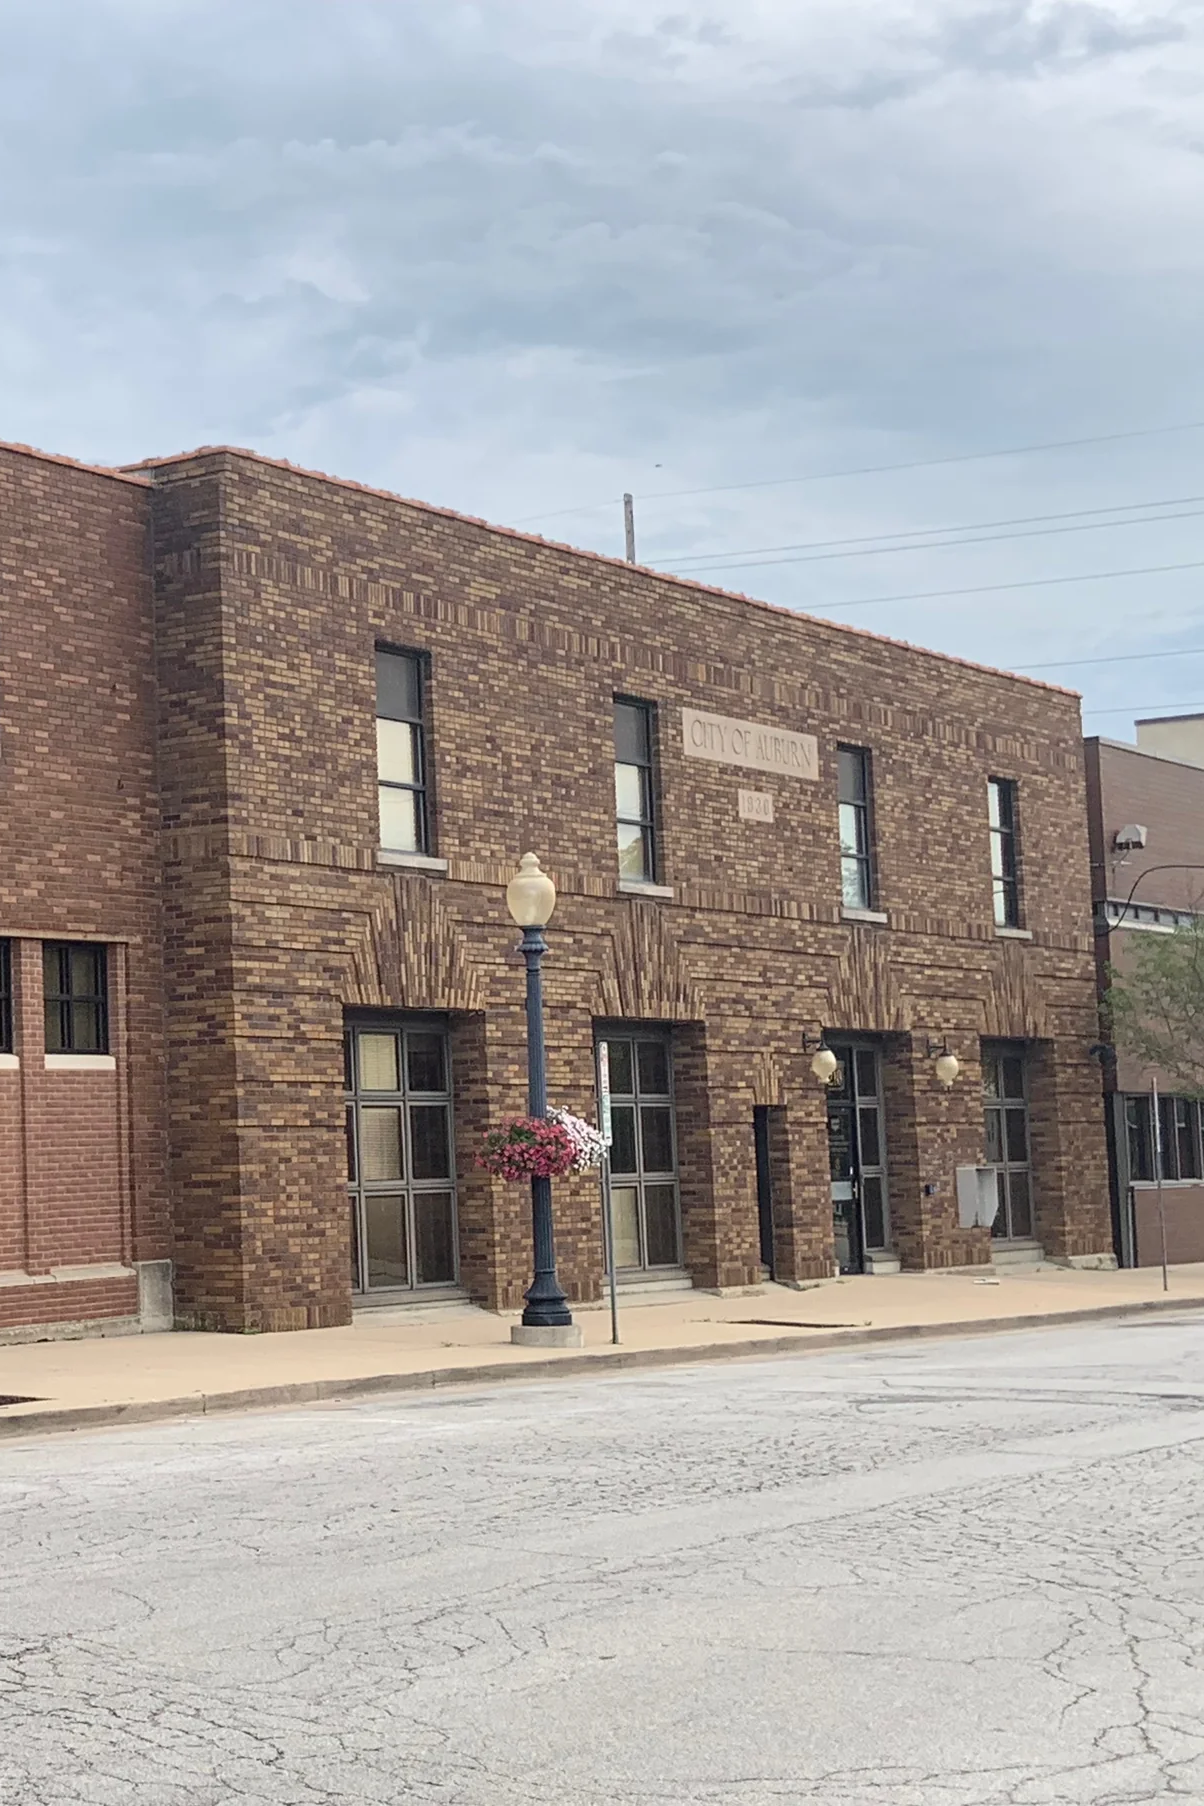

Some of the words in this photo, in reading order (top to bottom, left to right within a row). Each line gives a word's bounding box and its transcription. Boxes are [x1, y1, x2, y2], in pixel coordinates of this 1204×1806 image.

[691, 719, 727, 753] CITY
[731, 728, 751, 758] OF
[756, 733, 813, 768] AUBURN
